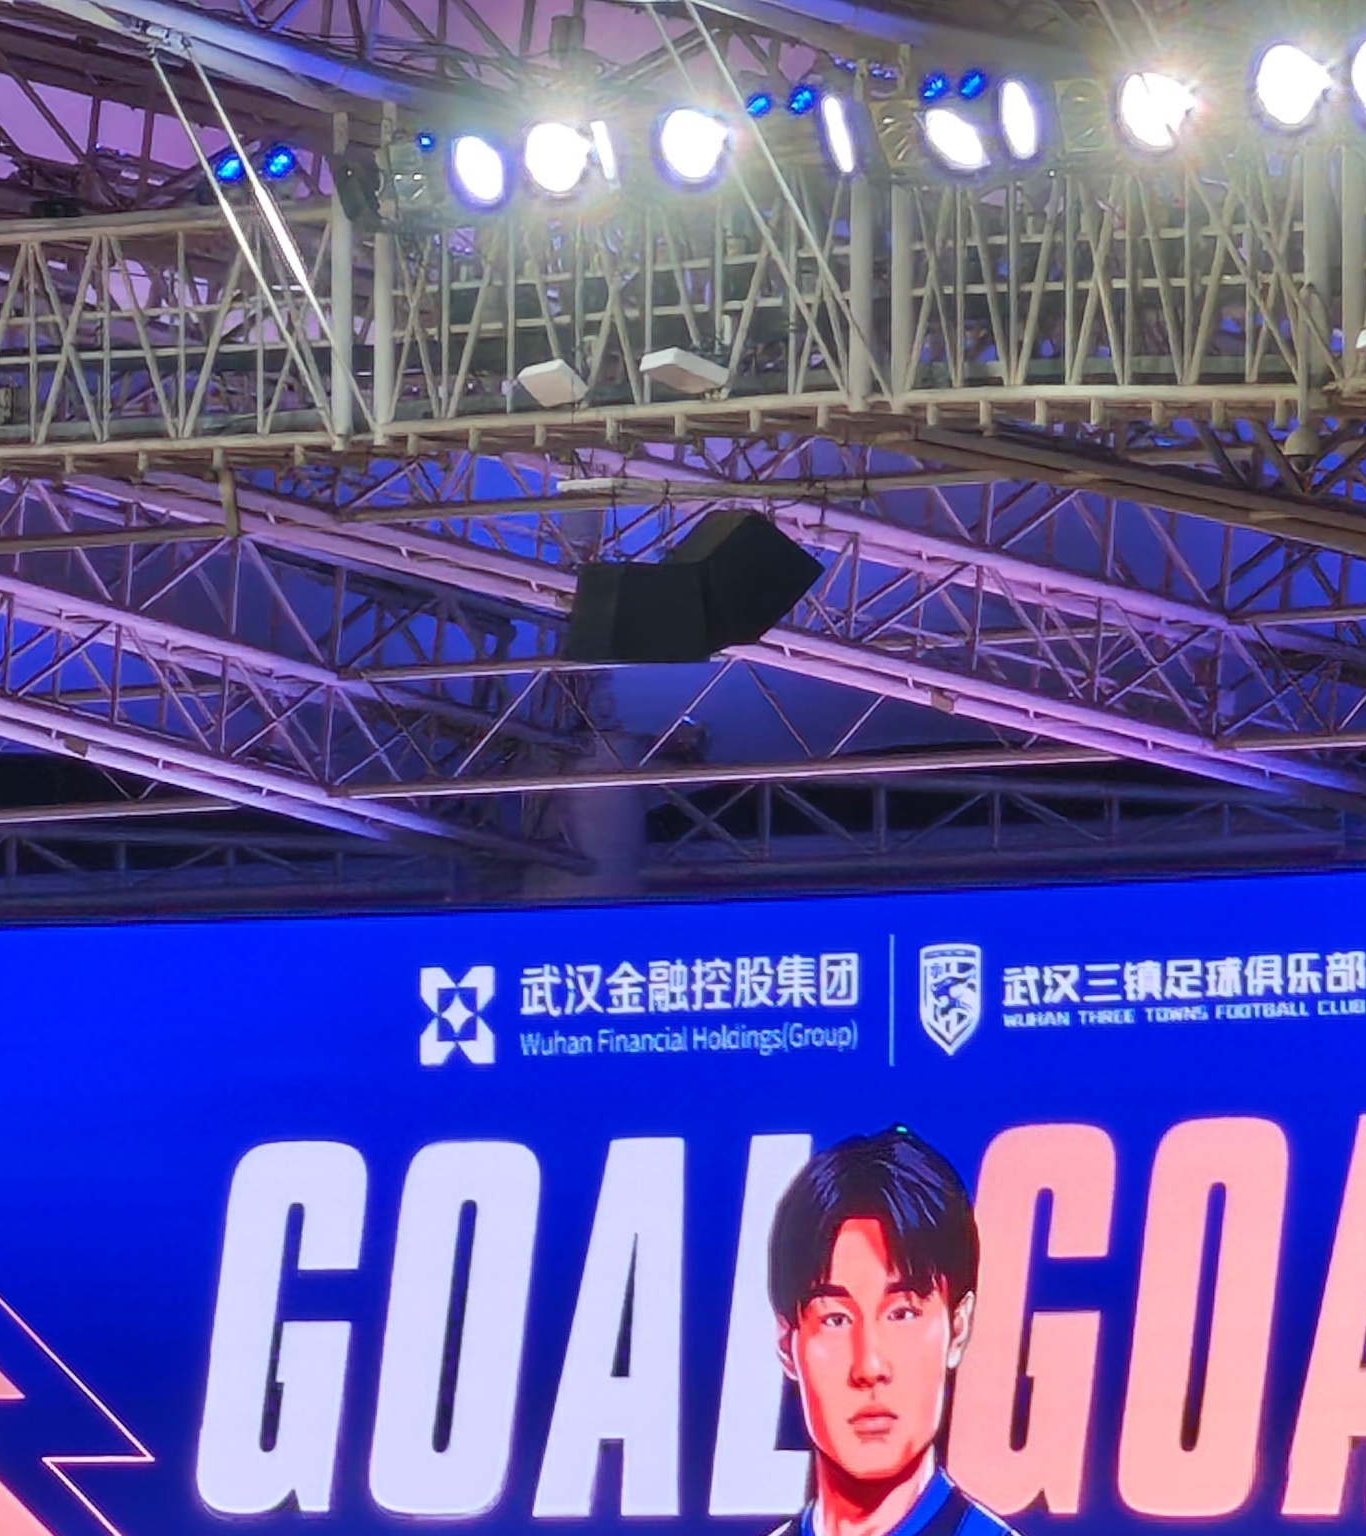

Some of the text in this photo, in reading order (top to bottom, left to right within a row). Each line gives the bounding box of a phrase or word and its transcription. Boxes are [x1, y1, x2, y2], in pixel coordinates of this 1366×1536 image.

[520, 953, 860, 1017] 武汉金融控股集团
[1003, 999, 1366, 1027] WUHAN THREE TOWNS FOOTBALL CLUB
[521, 1031, 593, 1056] Wuhan
[597, 1027, 688, 1053] Financial
[194, 1132, 817, 1519] GOAL
